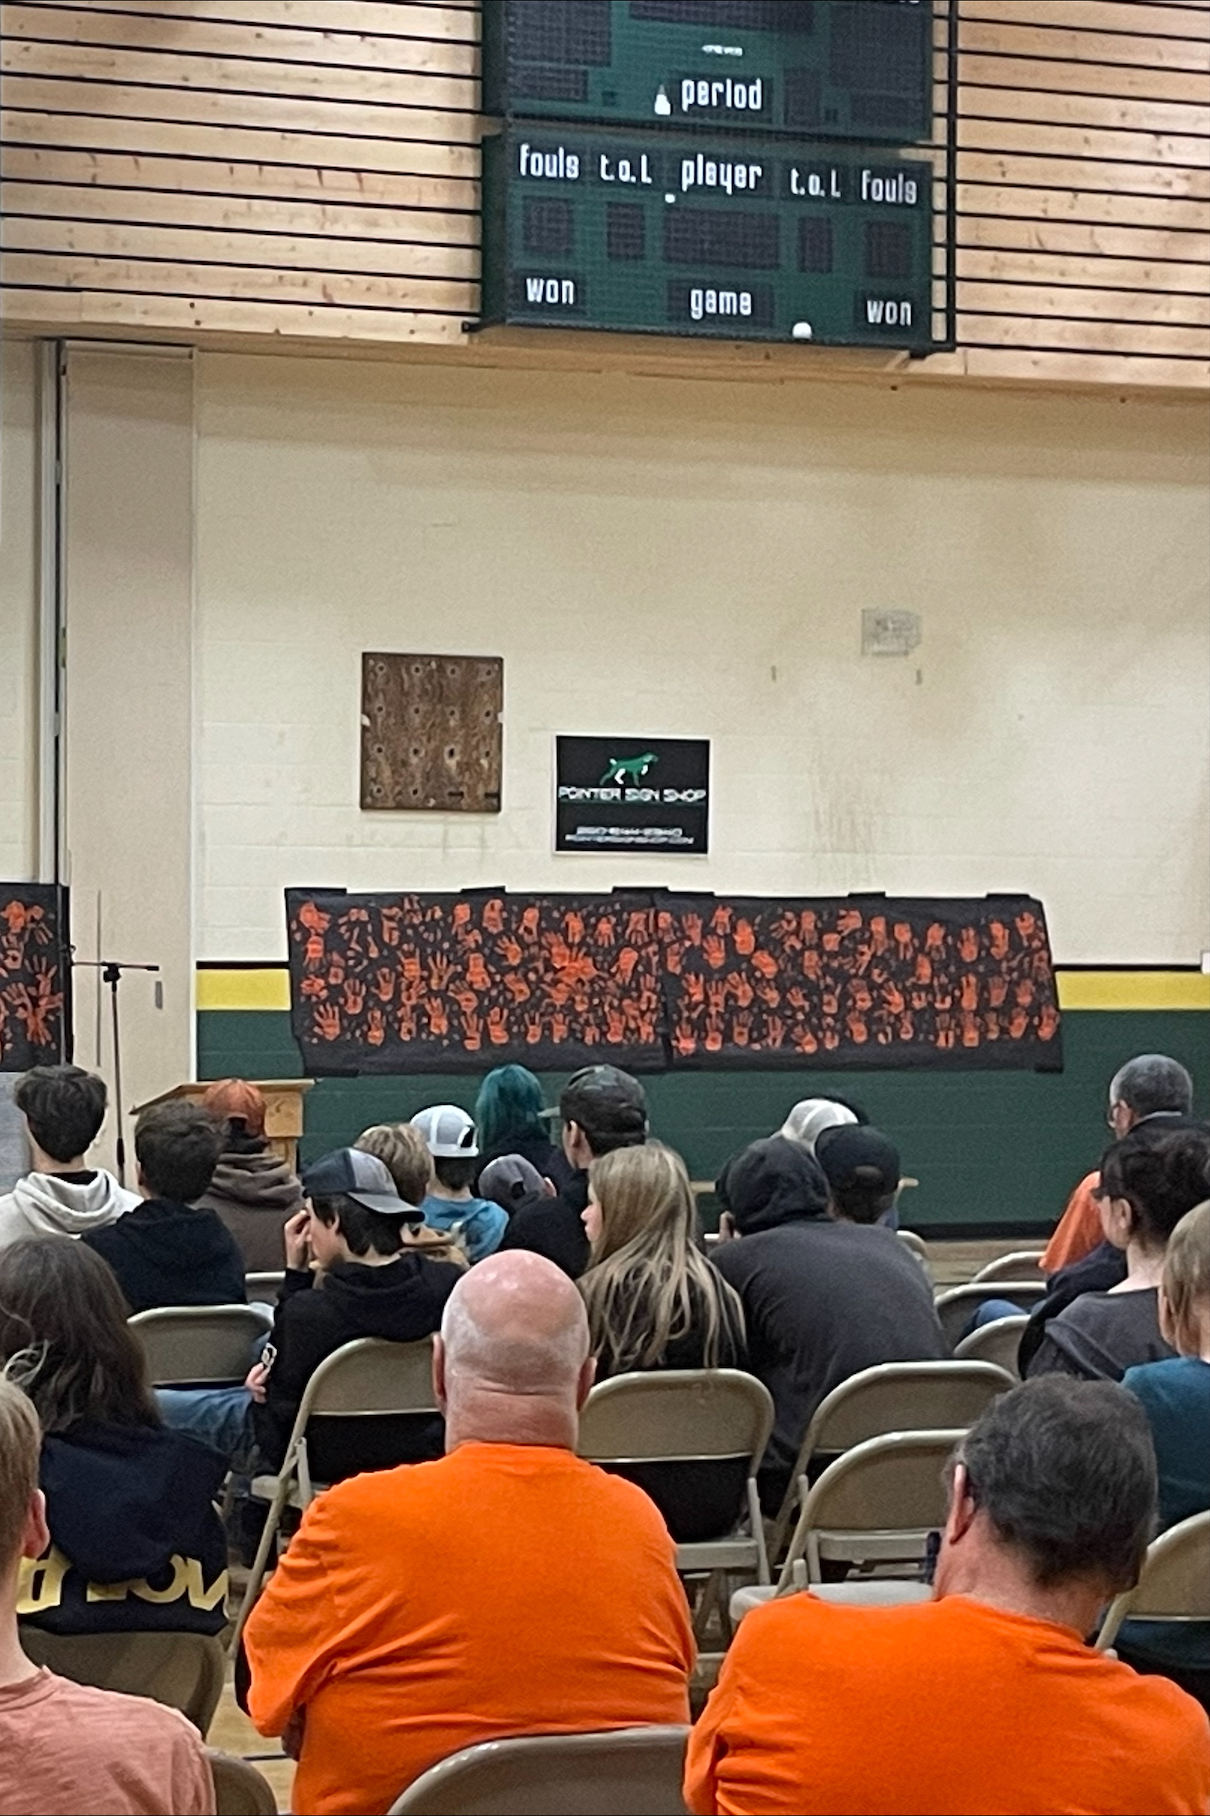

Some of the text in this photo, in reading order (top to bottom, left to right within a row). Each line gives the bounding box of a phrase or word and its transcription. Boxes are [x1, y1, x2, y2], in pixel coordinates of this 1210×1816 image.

[681, 78, 762, 112] period
[520, 143, 580, 179] fouls
[681, 153, 762, 195] player
[861, 169, 918, 204] fouls
[526, 277, 575, 305] won
[690, 288, 752, 320] game
[866, 299, 912, 326] won
